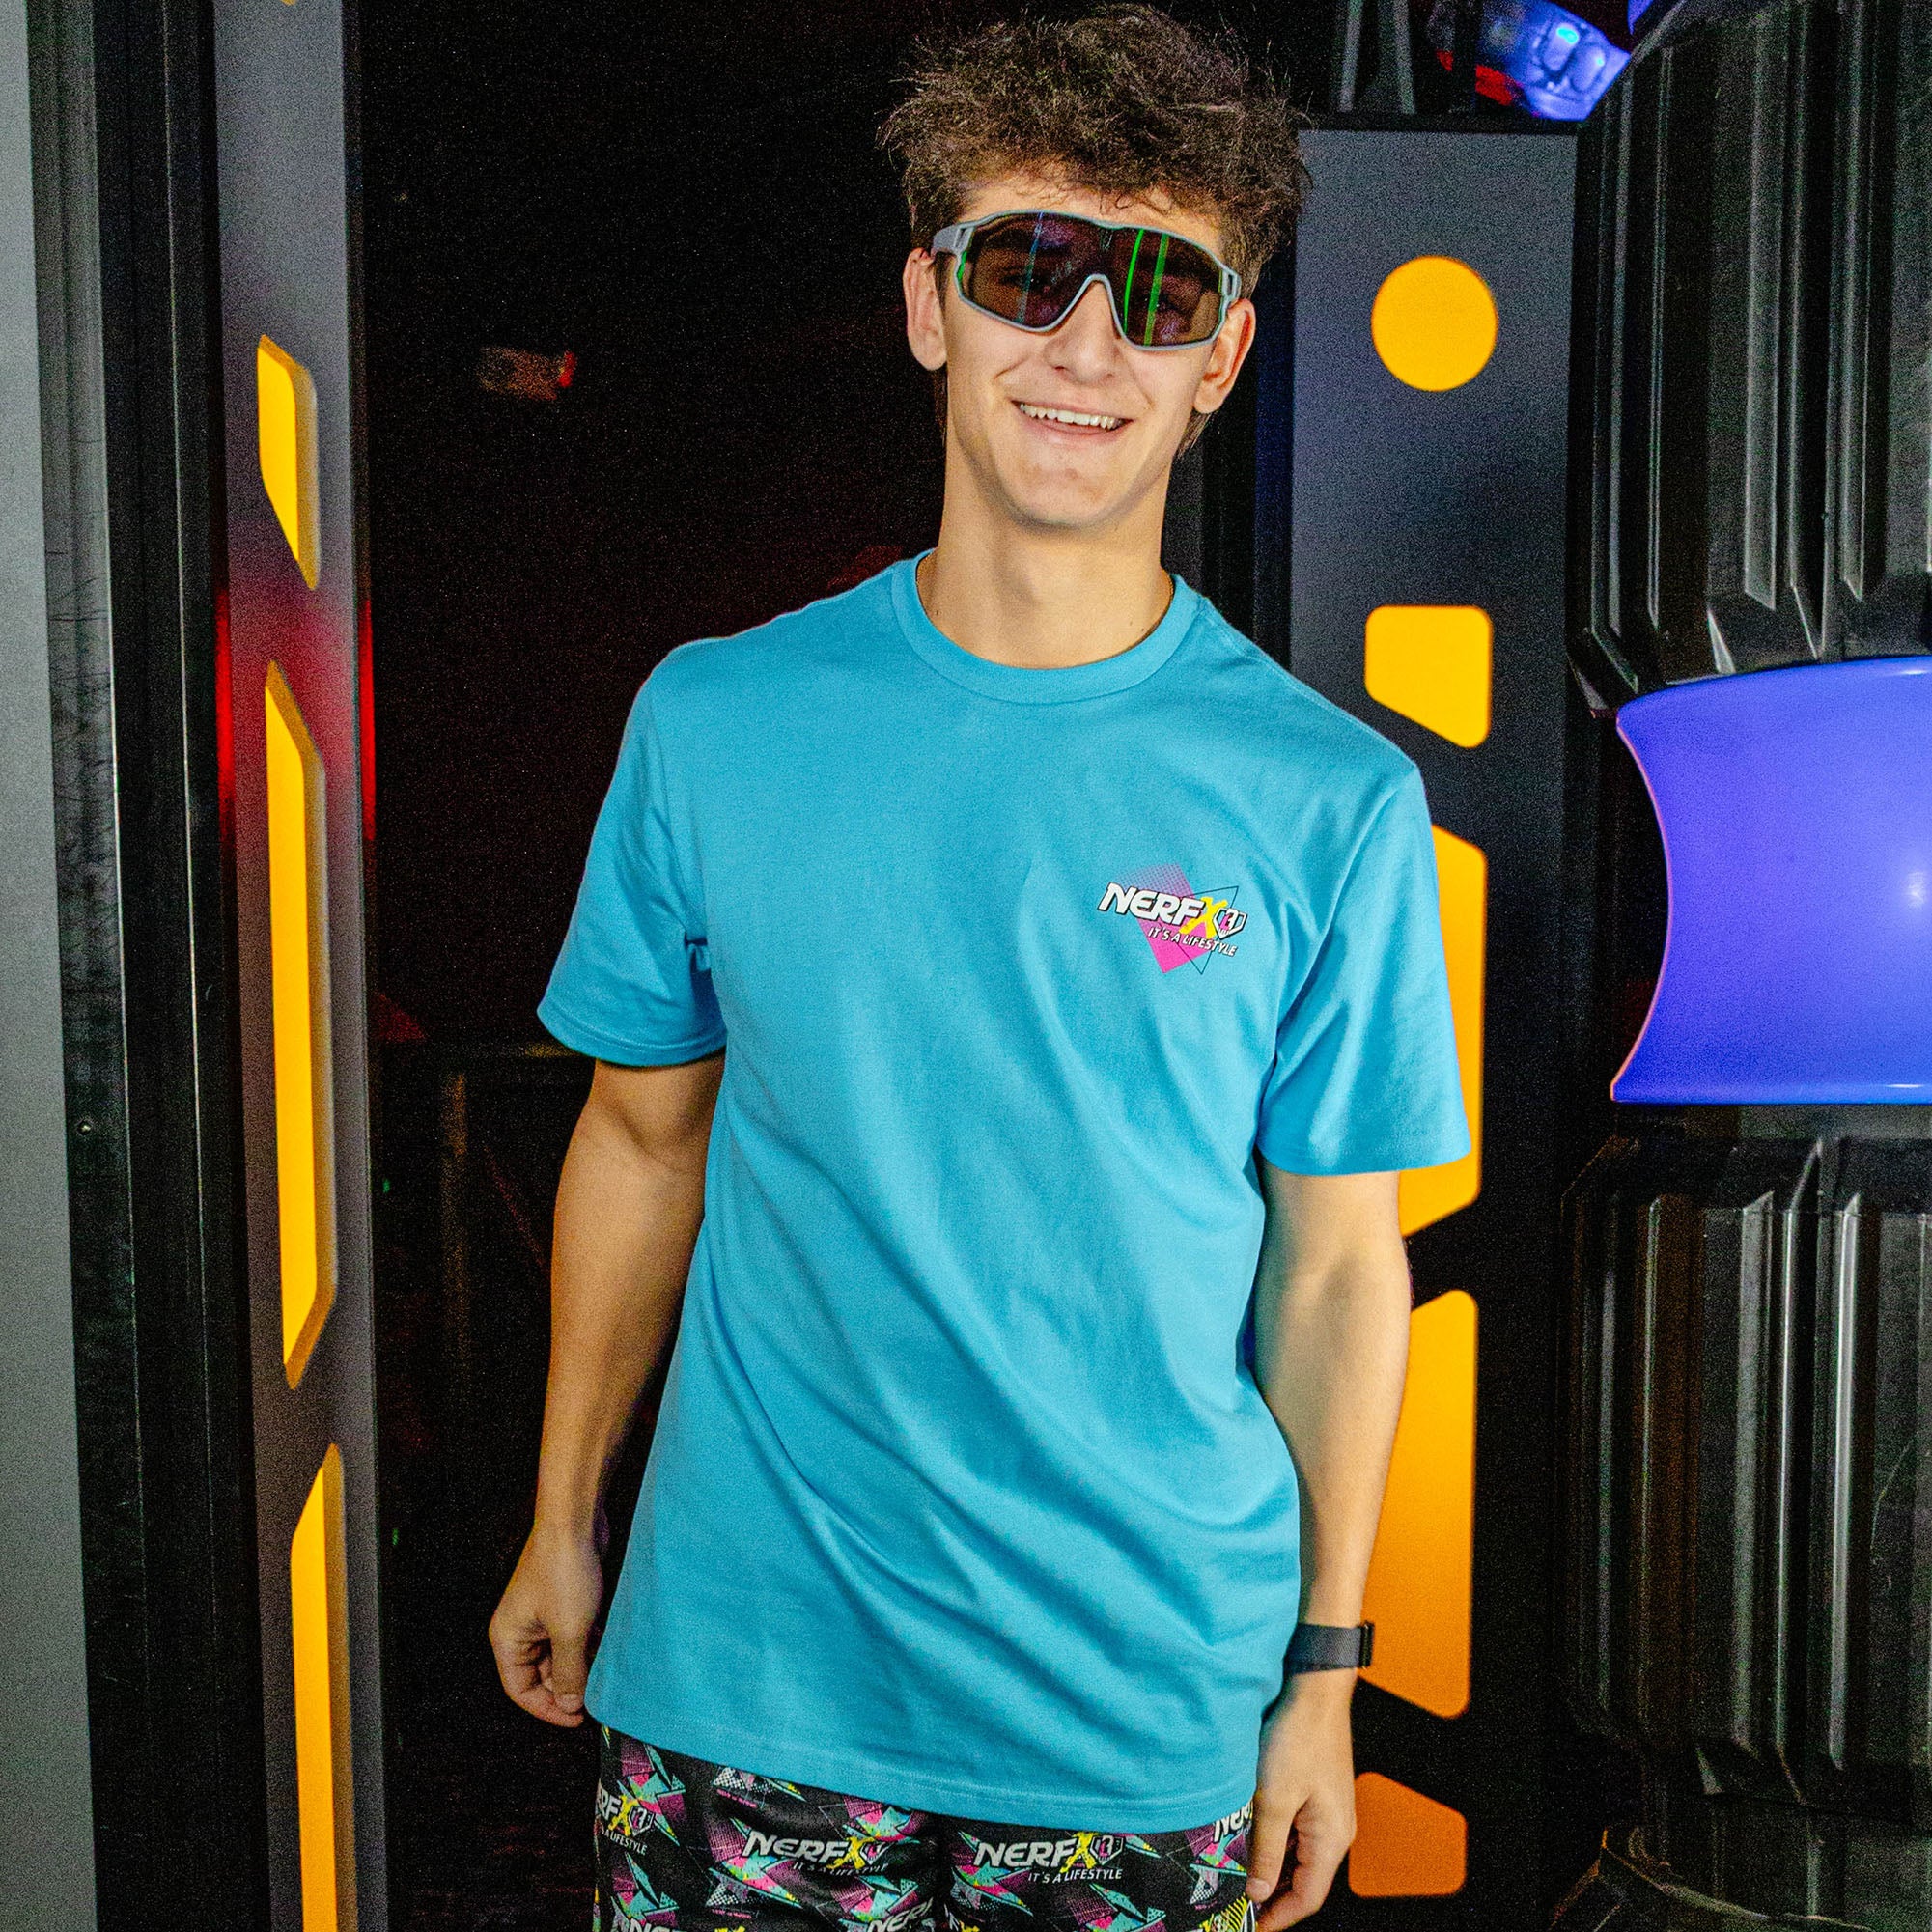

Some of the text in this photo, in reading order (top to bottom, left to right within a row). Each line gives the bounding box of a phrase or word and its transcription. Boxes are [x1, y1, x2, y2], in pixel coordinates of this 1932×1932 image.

[1148, 926, 1239, 957] IT'S A LIFESTYLE
[1027, 1869, 1123, 1884] IT'S A LIFESTYLE
